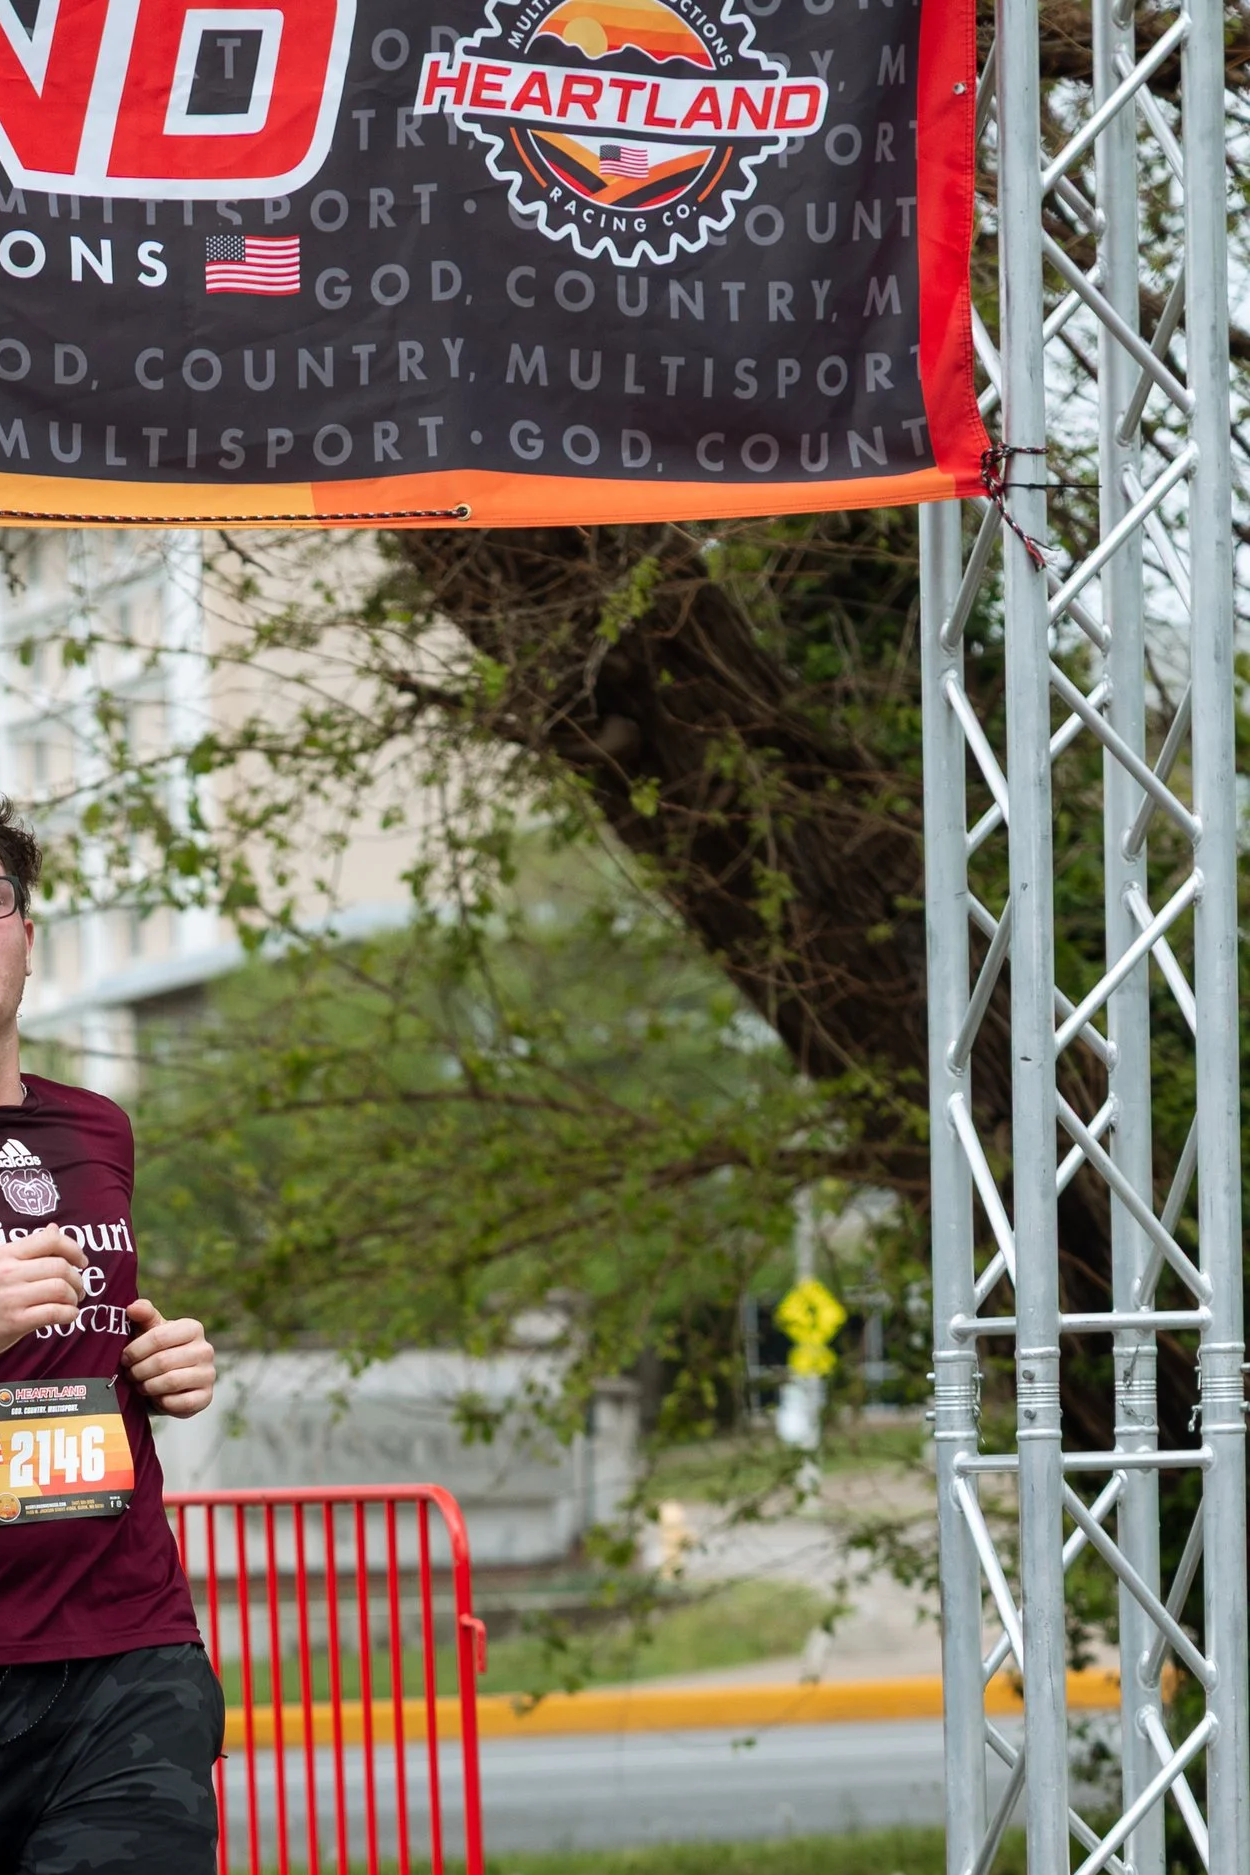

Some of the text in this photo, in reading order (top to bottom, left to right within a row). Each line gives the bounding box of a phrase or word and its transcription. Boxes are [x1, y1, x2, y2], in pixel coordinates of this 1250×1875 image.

[421, 60, 822, 131] HEARTLAND
[549, 187, 647, 233] RACING
[661, 205, 698, 225] CO.
[315, 260, 473, 311] GOD,
[506, 270, 838, 324] COUNTRY,
[134, 336, 476, 392] COUNTRY,
[509, 419, 664, 473] GOD,
[15, 1385, 87, 1400] HEARTLAND
[9, 1426, 105, 1488] 2146
